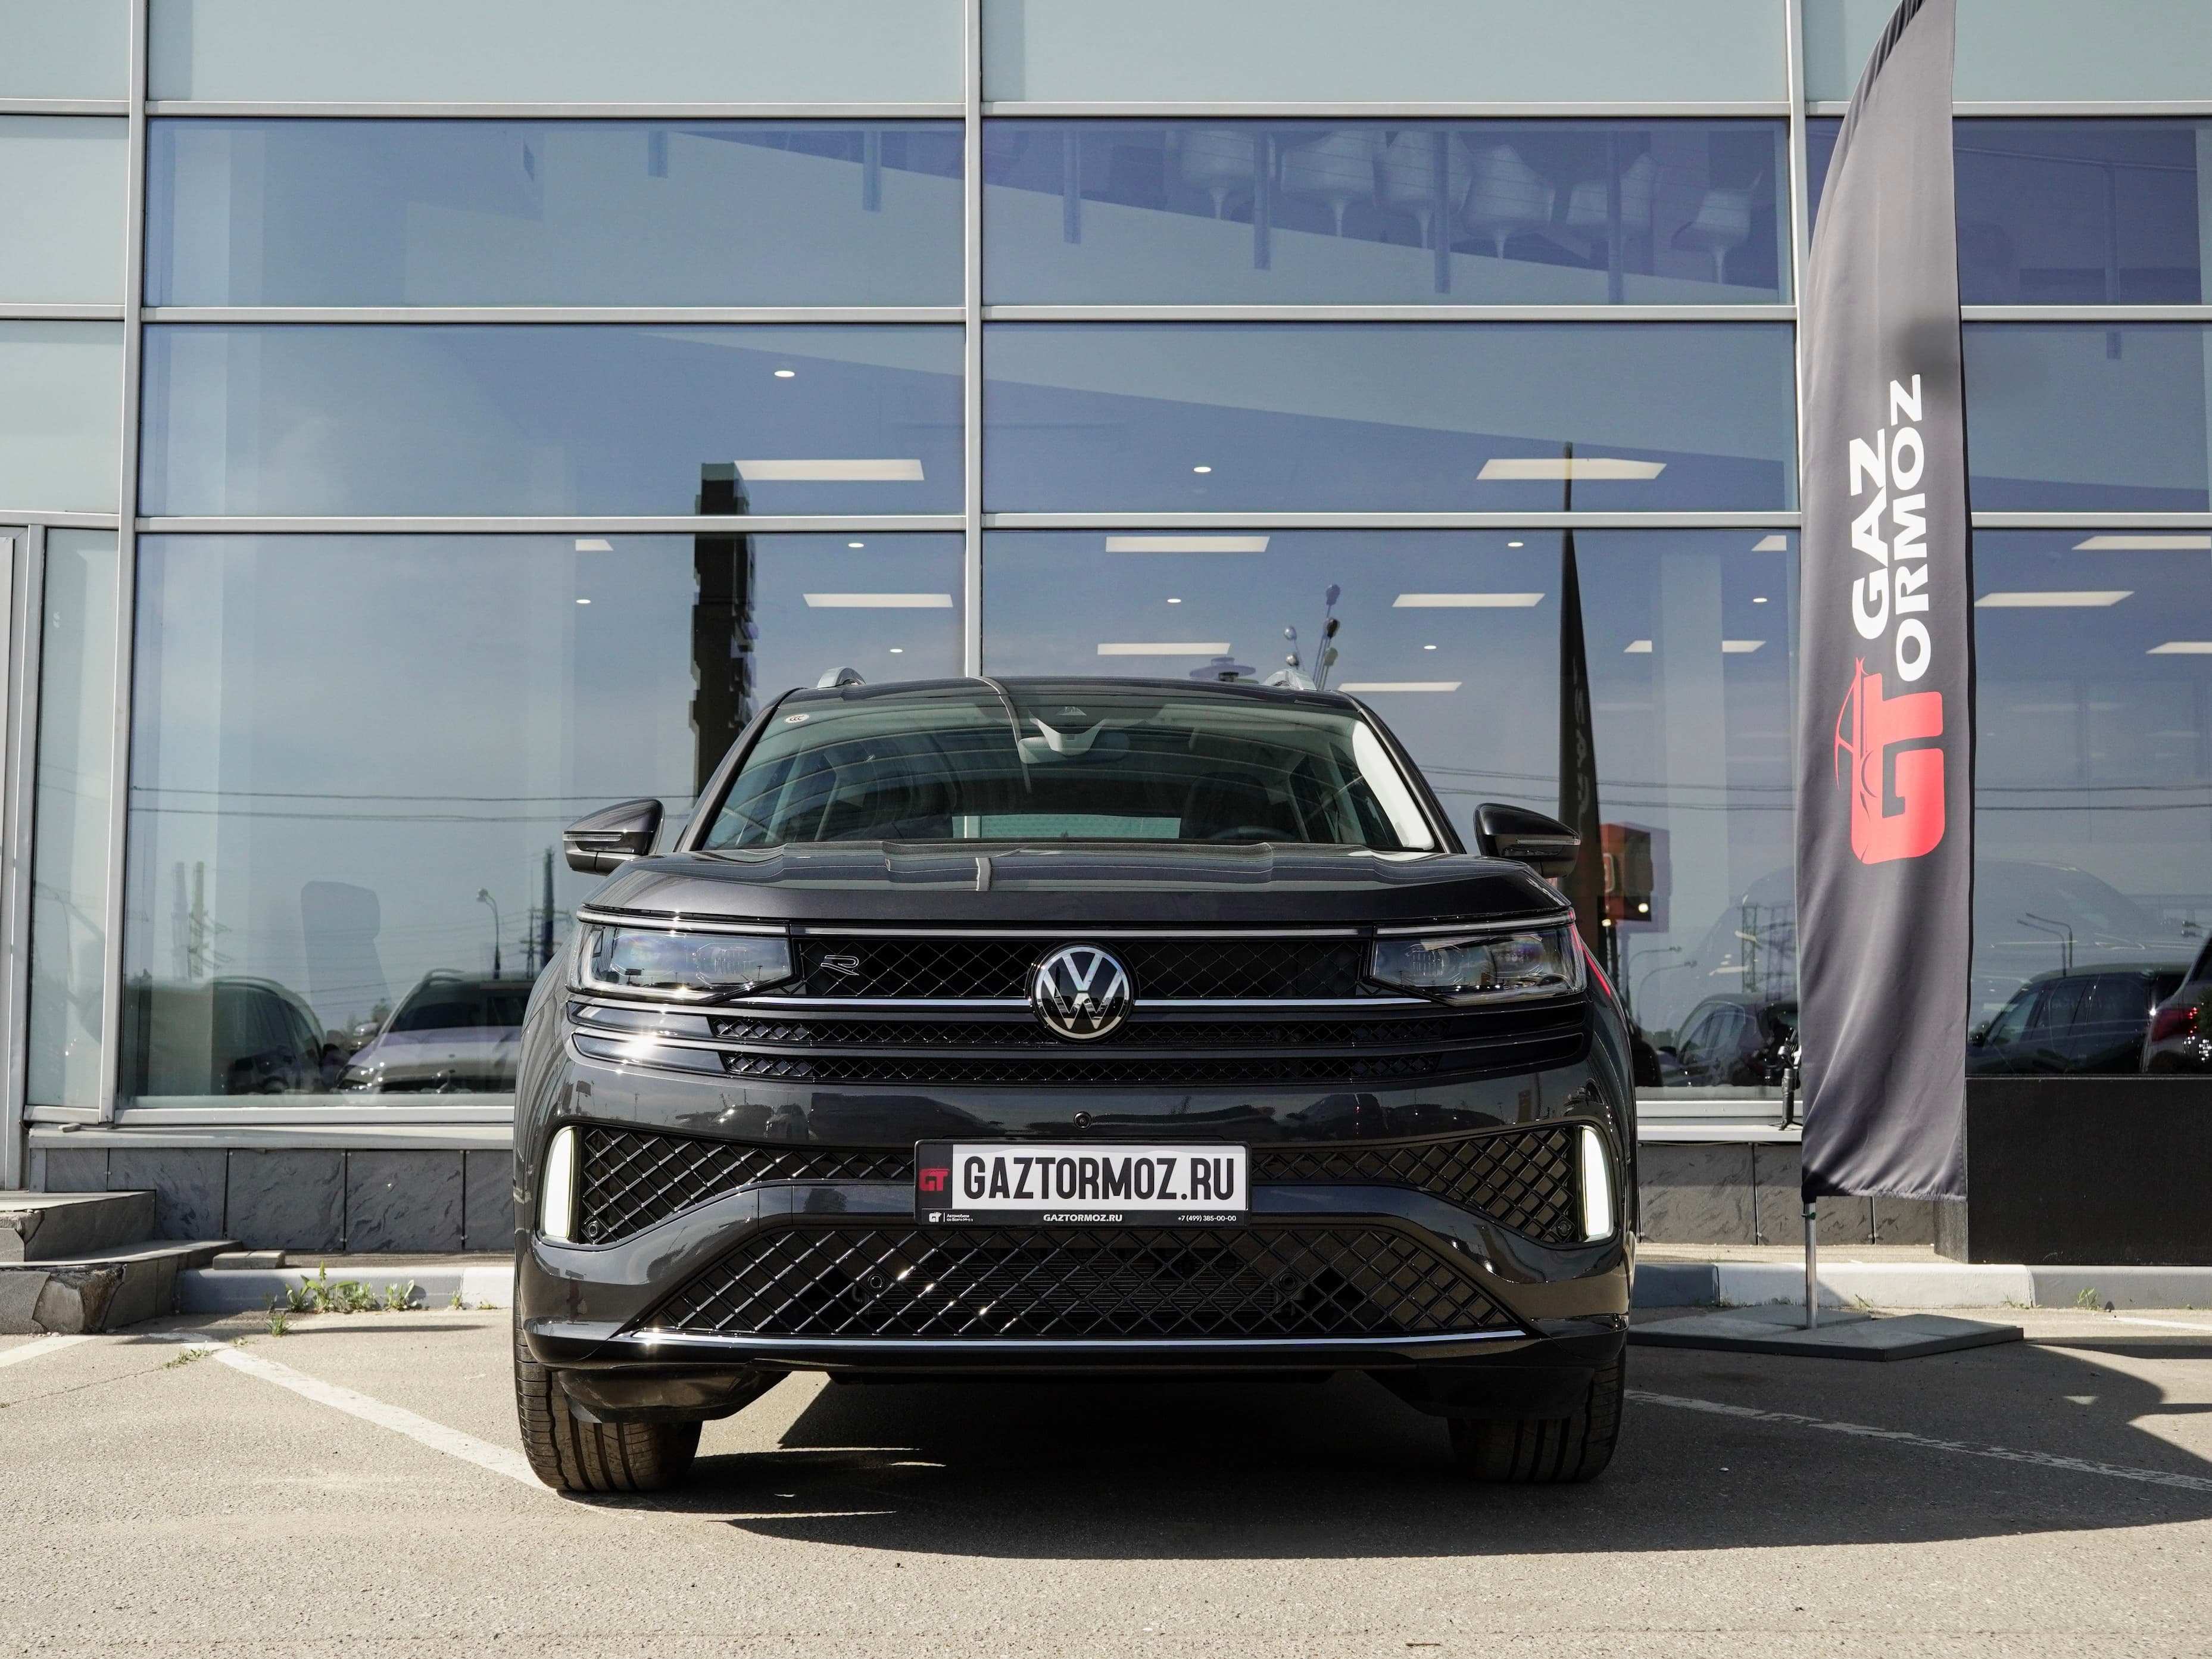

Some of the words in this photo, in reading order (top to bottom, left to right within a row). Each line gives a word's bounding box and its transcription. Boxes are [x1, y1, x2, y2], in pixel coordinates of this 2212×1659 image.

[1849, 429, 1889, 640] GAZ
[1890, 374, 1931, 682] ORMOZ
[963, 1156, 1234, 1200] GAZTORMOZ.RU
